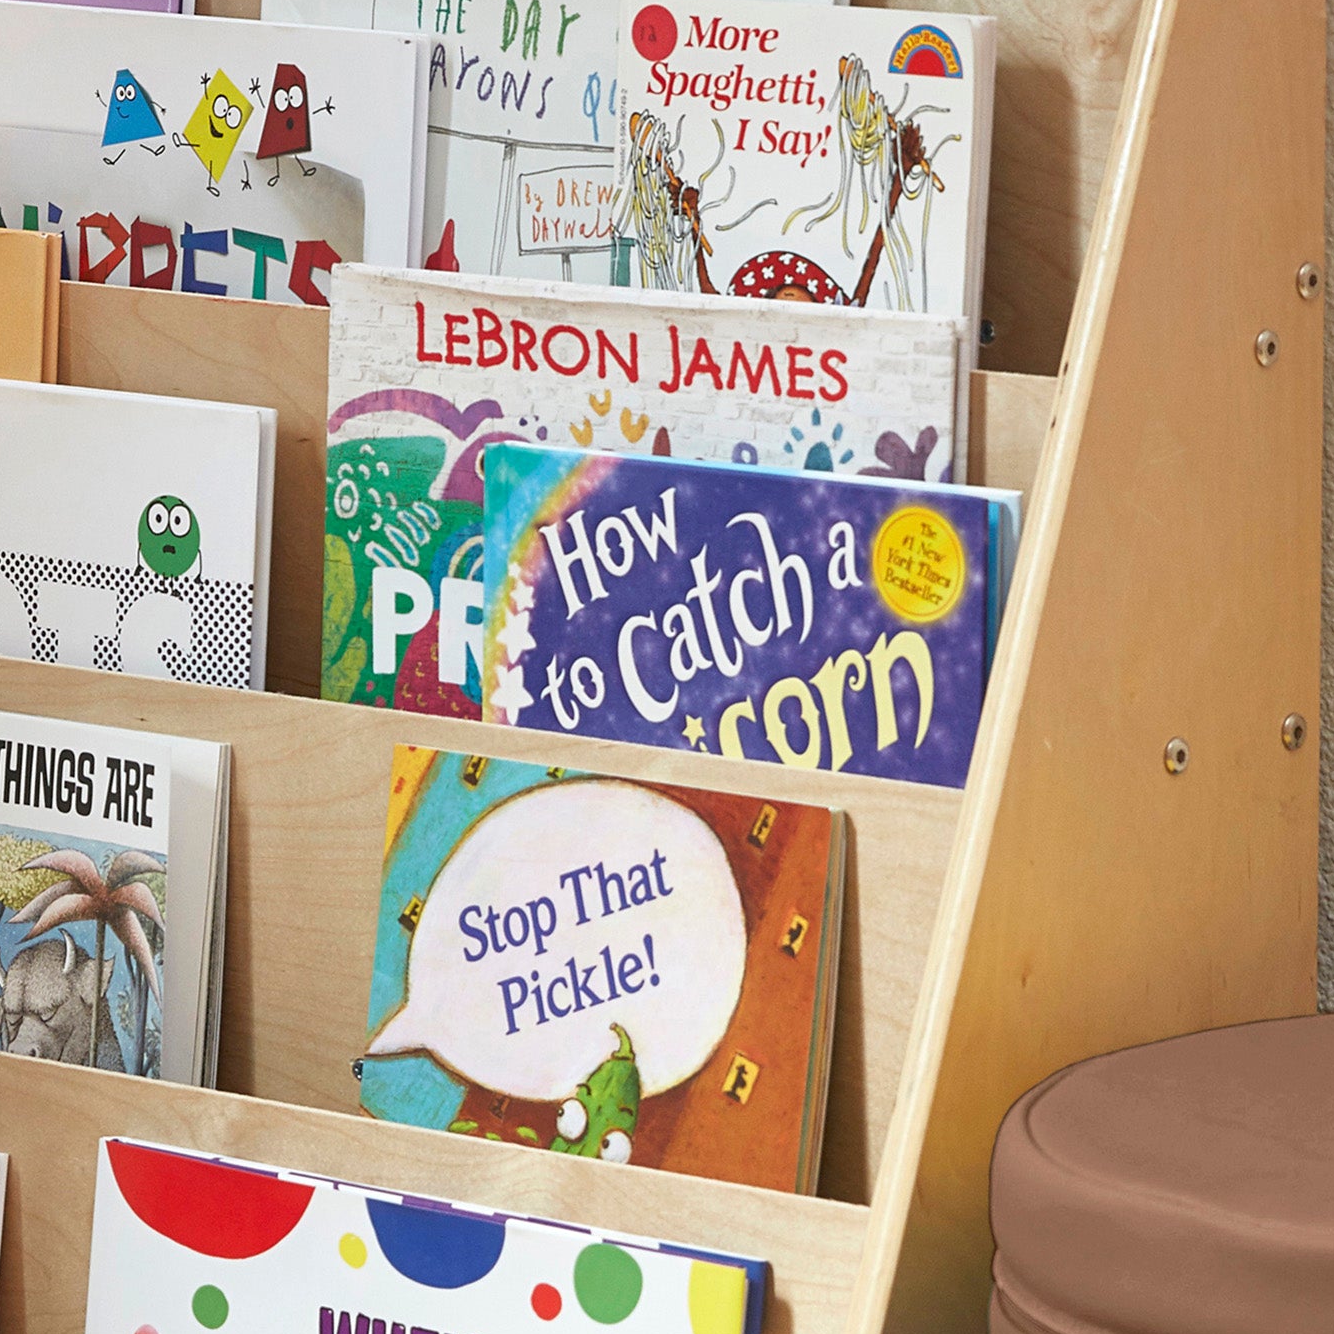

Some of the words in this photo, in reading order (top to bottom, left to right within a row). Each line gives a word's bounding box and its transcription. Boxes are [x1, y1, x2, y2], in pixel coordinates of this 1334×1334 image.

[684, 15, 780, 53] More
[646, 61, 826, 114] Spaghetti,
[733, 118, 751, 150] I
[757, 120, 832, 168] Say!
[557, 178, 613, 207] DREW
[659, 325, 848, 403] JAMES
[539, 487, 677, 620] How
[884, 567, 944, 605] Bestseller
[540, 654, 605, 730] to
[617, 512, 814, 723] Catch
[827, 521, 864, 590] a
[699, 630, 934, 772] corn
[103, 757, 155, 827] ARE
[458, 896, 557, 963] Stop
[560, 848, 674, 927] That
[497, 934, 662, 1036] Pickle!
